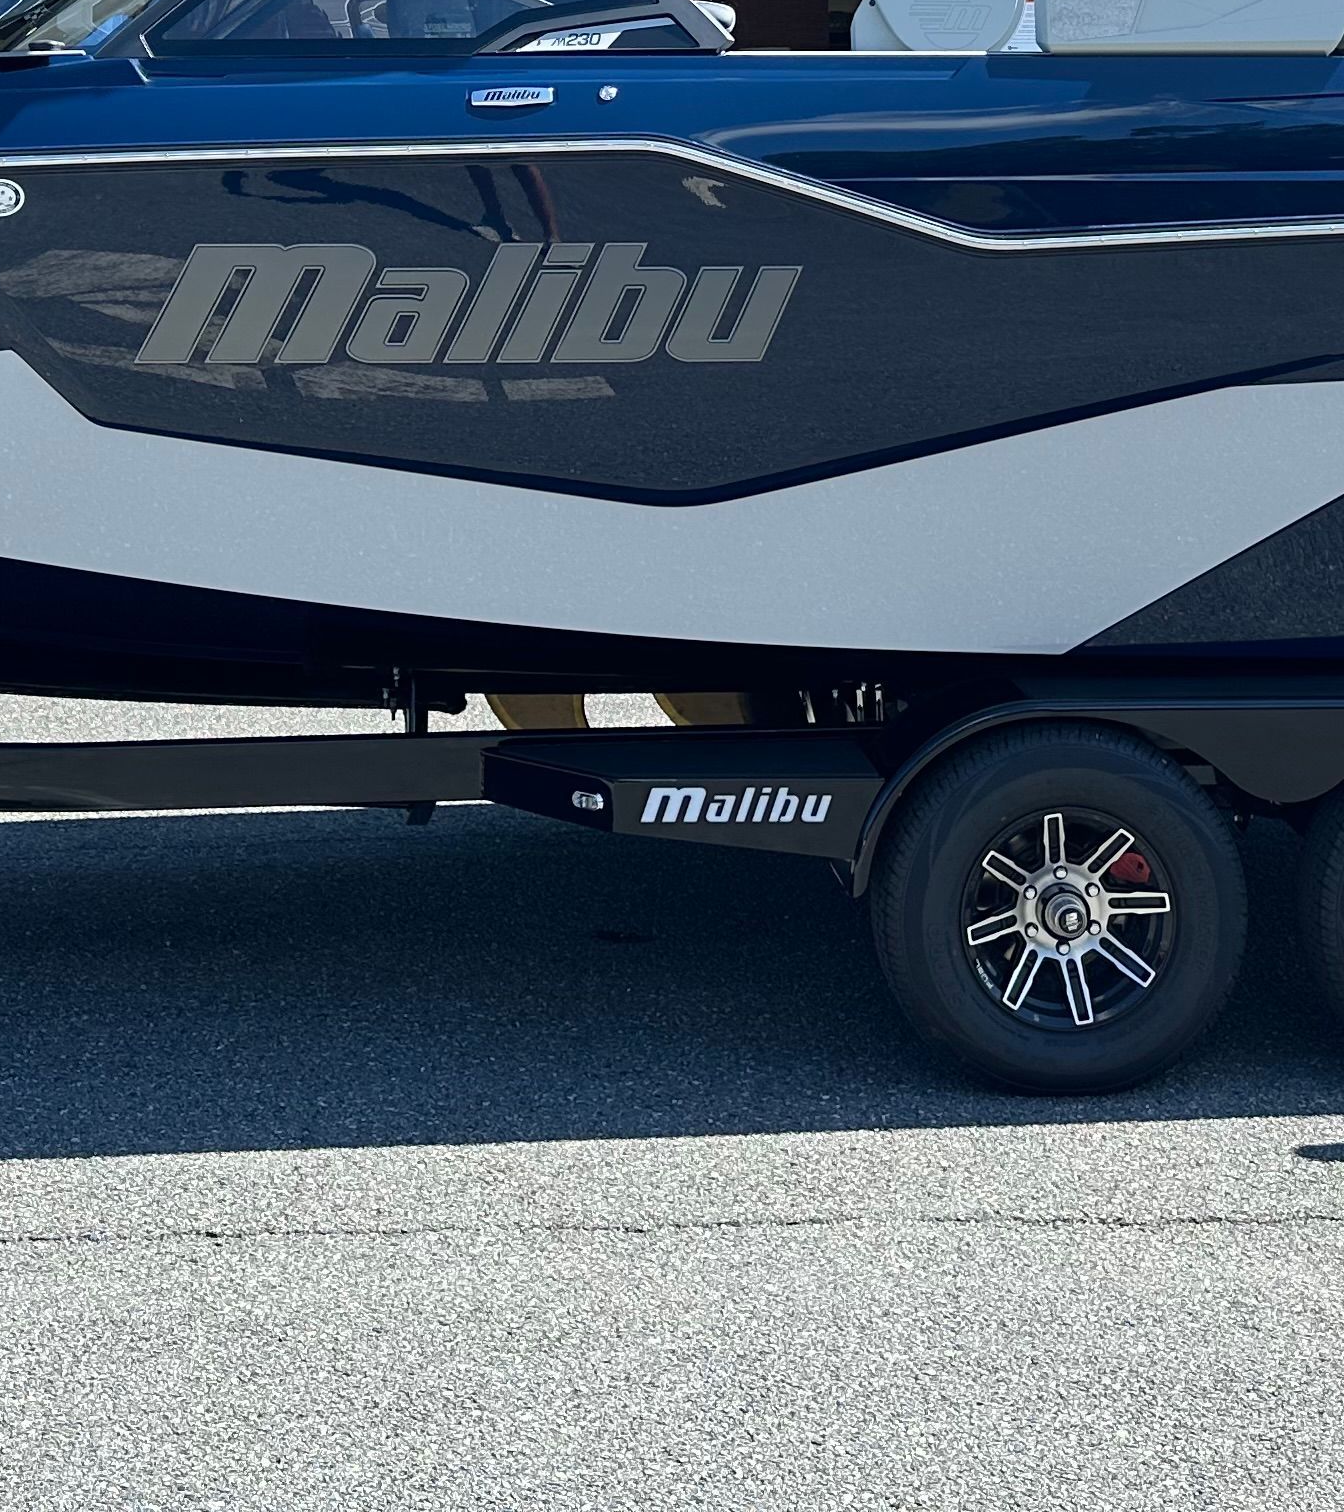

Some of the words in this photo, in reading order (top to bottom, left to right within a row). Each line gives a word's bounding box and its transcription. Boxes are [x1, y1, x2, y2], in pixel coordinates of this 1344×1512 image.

[483, 88, 541, 101] Malibu
[134, 241, 803, 365] Malibu
[640, 786, 833, 823] Malibu
